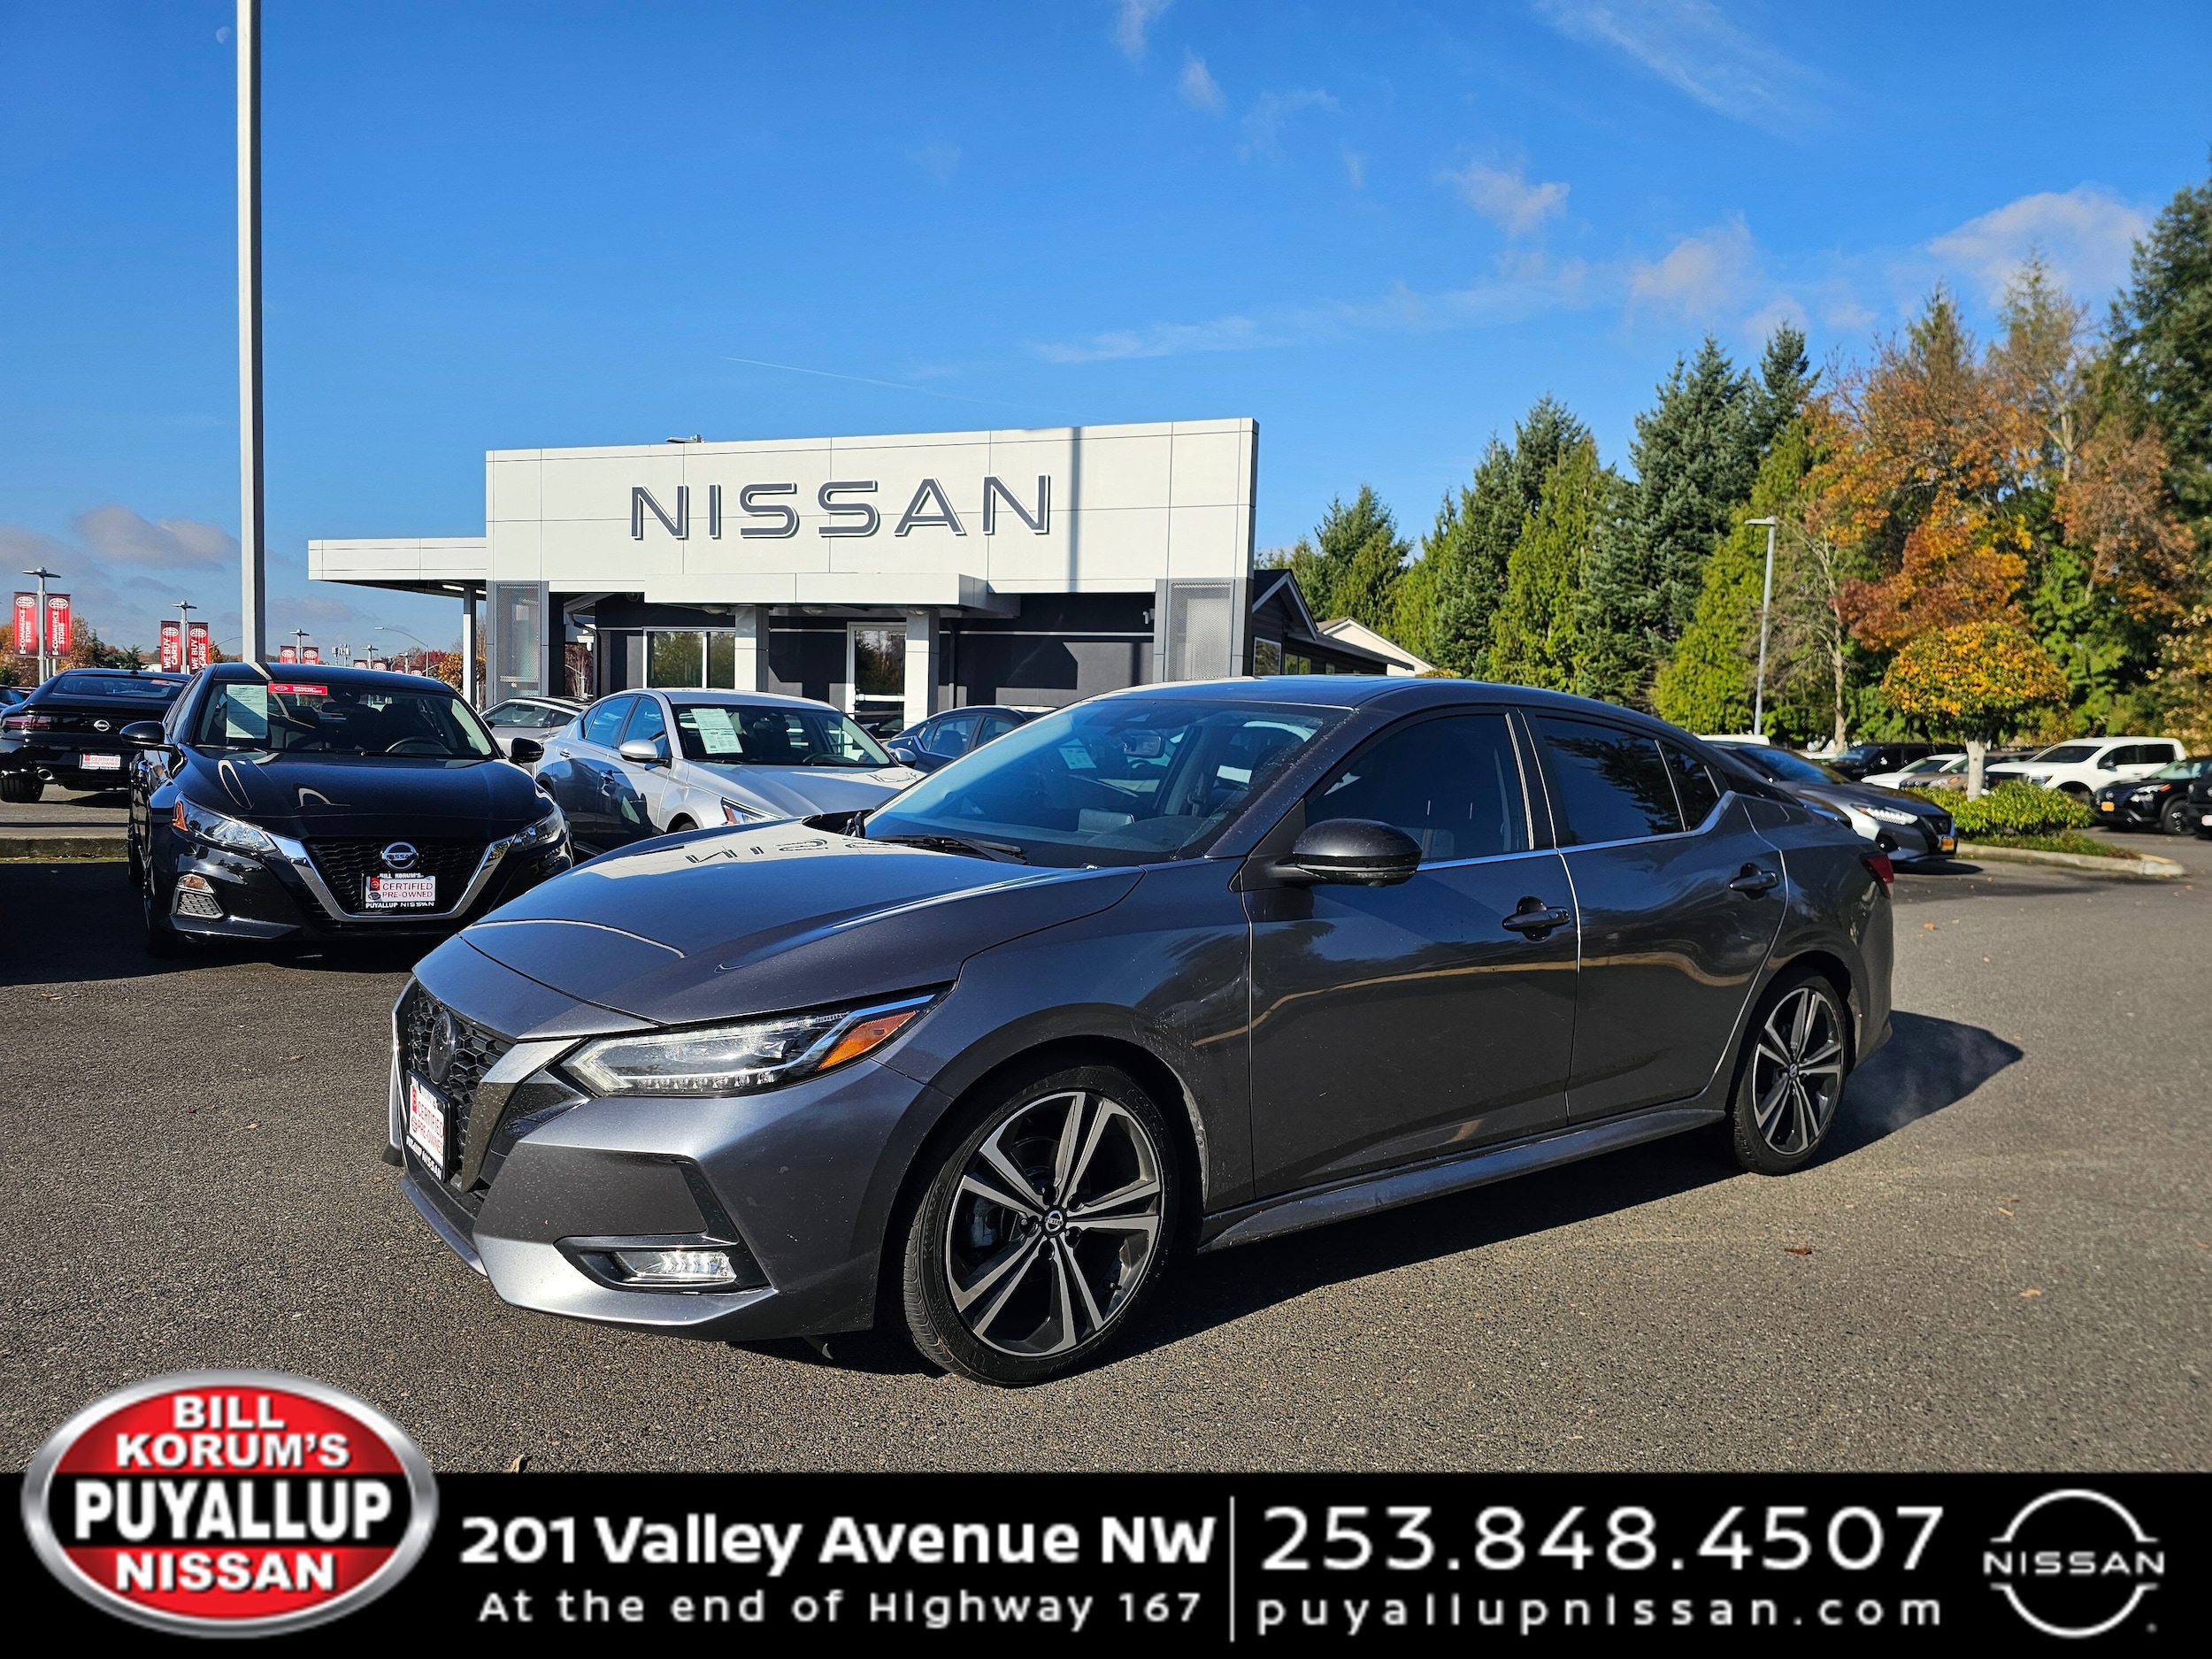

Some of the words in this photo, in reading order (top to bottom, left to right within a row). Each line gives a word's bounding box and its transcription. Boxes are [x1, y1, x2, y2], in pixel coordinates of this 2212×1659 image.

[631, 475, 1050, 541] NISSAN
[164, 655, 171, 669] WE
[191, 657, 198, 670] WE
[418, 1101, 444, 1139] CERTIFIED
[418, 1119, 444, 1156] PRE-OWNED
[422, 1150, 442, 1180] NISSAN
